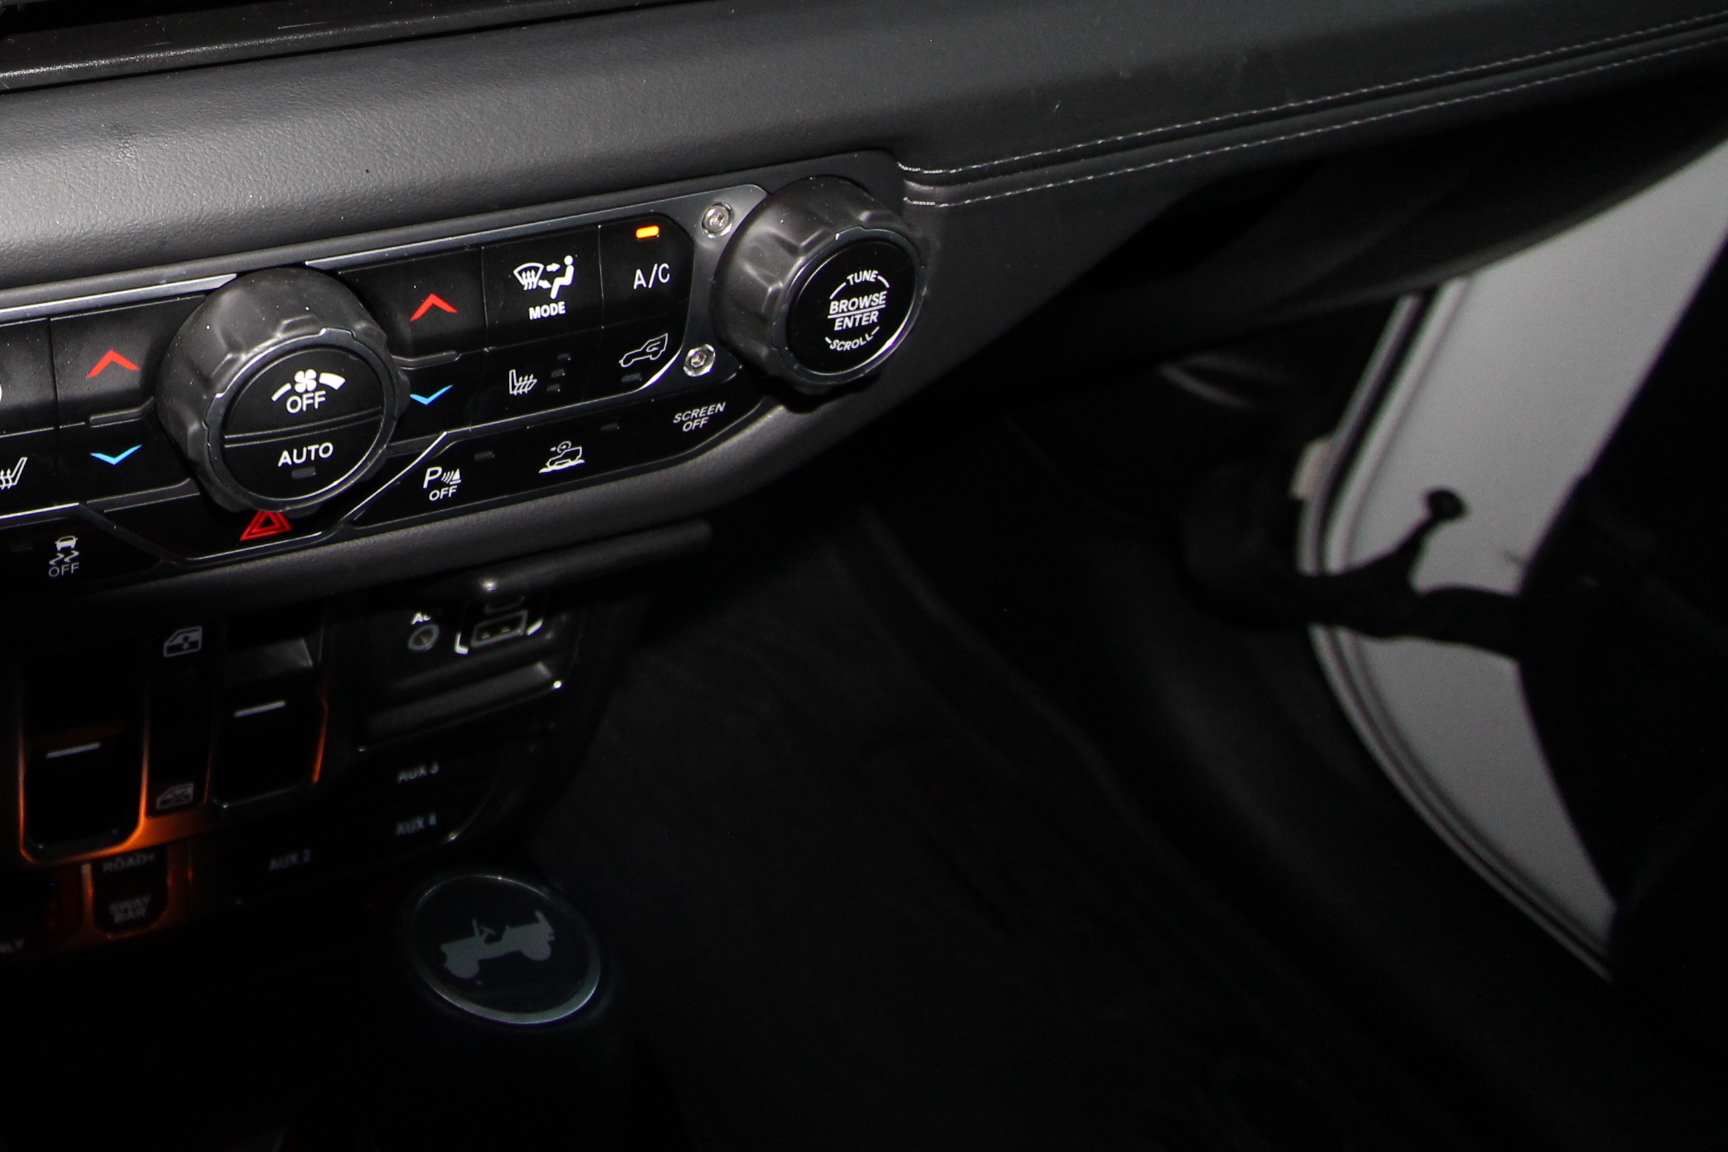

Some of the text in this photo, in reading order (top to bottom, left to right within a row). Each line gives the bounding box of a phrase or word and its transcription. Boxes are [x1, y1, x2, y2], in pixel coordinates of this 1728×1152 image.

[632, 262, 671, 291] A/C
[845, 269, 878, 286] TUNE
[528, 301, 567, 320] MODE
[828, 290, 888, 315] BROWSE
[833, 310, 880, 332] ENTER
[828, 331, 874, 353] SCROLL
[285, 392, 327, 415] OFF
[673, 402, 727, 425] SCREEN
[681, 415, 710, 433] OFF
[277, 441, 334, 469] AUTO
[428, 484, 459, 503] OFF
[47, 561, 80, 578] OFF
[397, 765, 428, 783] AUX
[395, 817, 426, 836] AUX
[269, 852, 300, 872] AUX
